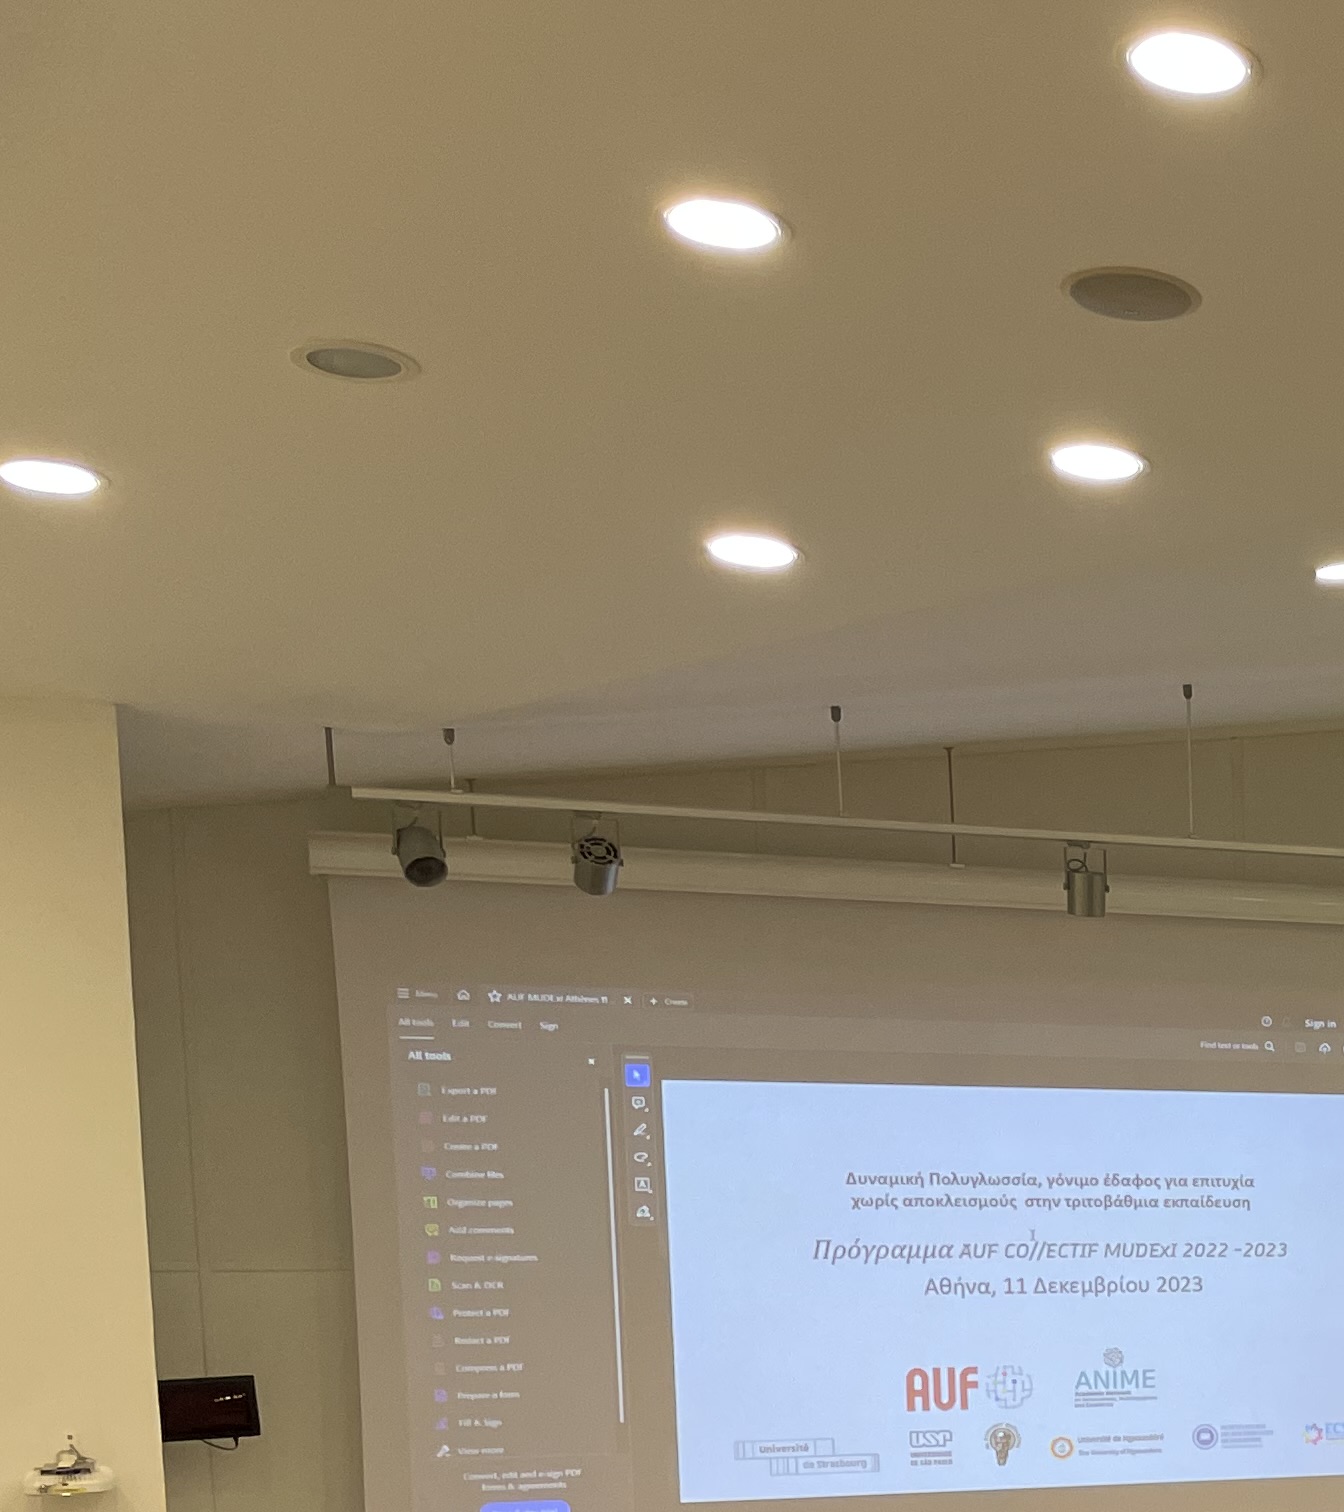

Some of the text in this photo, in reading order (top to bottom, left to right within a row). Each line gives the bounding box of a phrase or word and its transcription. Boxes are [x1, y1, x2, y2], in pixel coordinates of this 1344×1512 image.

[1304, 1019, 1337, 1030] Sign in
[408, 1051, 451, 1062] All tools
[845, 1171, 1255, 1190] Δυναμική Πολυγλωσσία, γόνιμο έδαφος για επιτυχία
[851, 1193, 1251, 1211] χωρίς αποκλεισμούς στην τριτοβάθμια εκπαίδευση
[813, 1238, 954, 1265] Πρόγραμμα
[958, 1242, 999, 1259] AUF
[1004, 1241, 1099, 1261] CO//ECTIF
[1104, 1242, 1177, 1259] MUDExI
[1182, 1242, 1228, 1258] 2022
[924, 1275, 1203, 1298] Αθήνα, 11 Δεκεμβρίου 2023
[1074, 1368, 1156, 1390] ANIME
[906, 1366, 978, 1412] AUF
[909, 1430, 952, 1448] USP
[759, 1444, 809, 1454] Université
[817, 1459, 867, 1471] Strasbourg
